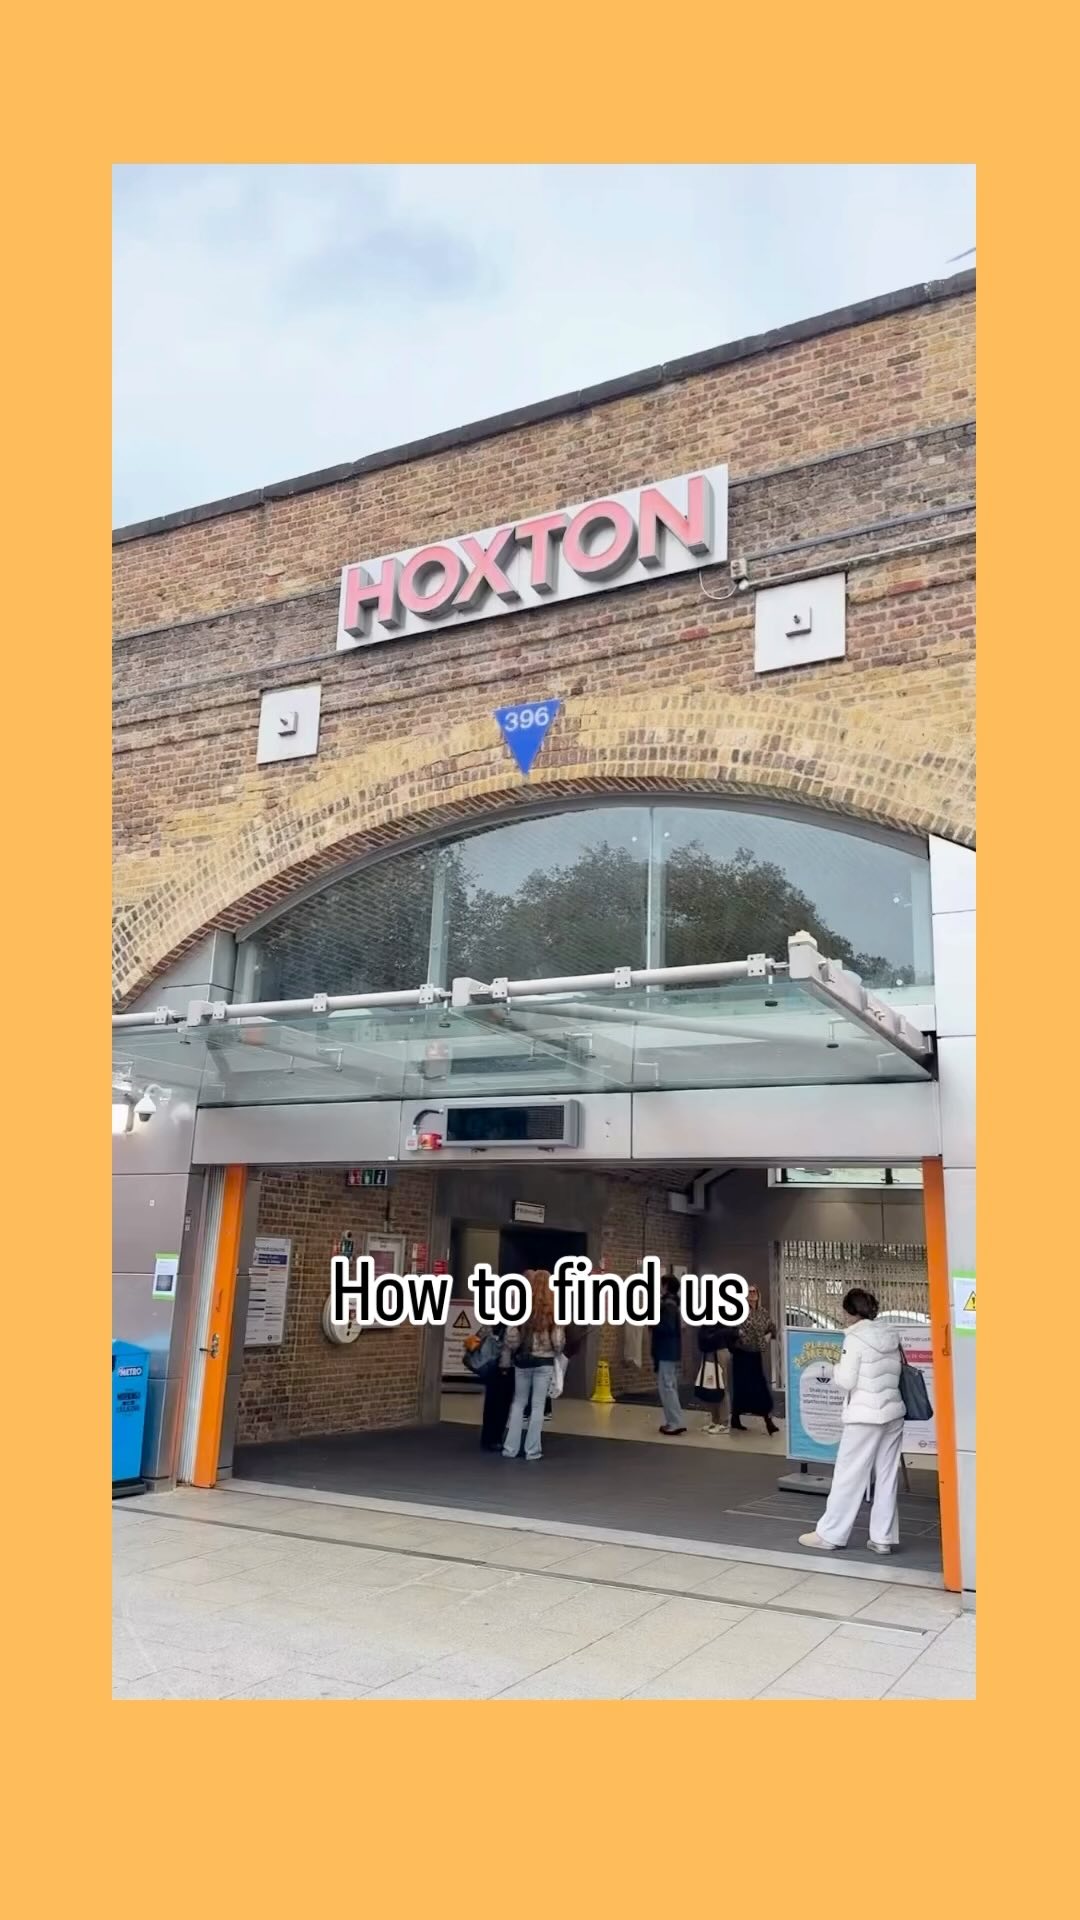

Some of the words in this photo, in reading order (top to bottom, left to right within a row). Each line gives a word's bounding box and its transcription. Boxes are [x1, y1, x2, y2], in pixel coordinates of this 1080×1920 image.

[344, 475, 709, 637] HOXTON
[504, 706, 549, 732] 396
[119, 1367, 143, 1377] METRO
